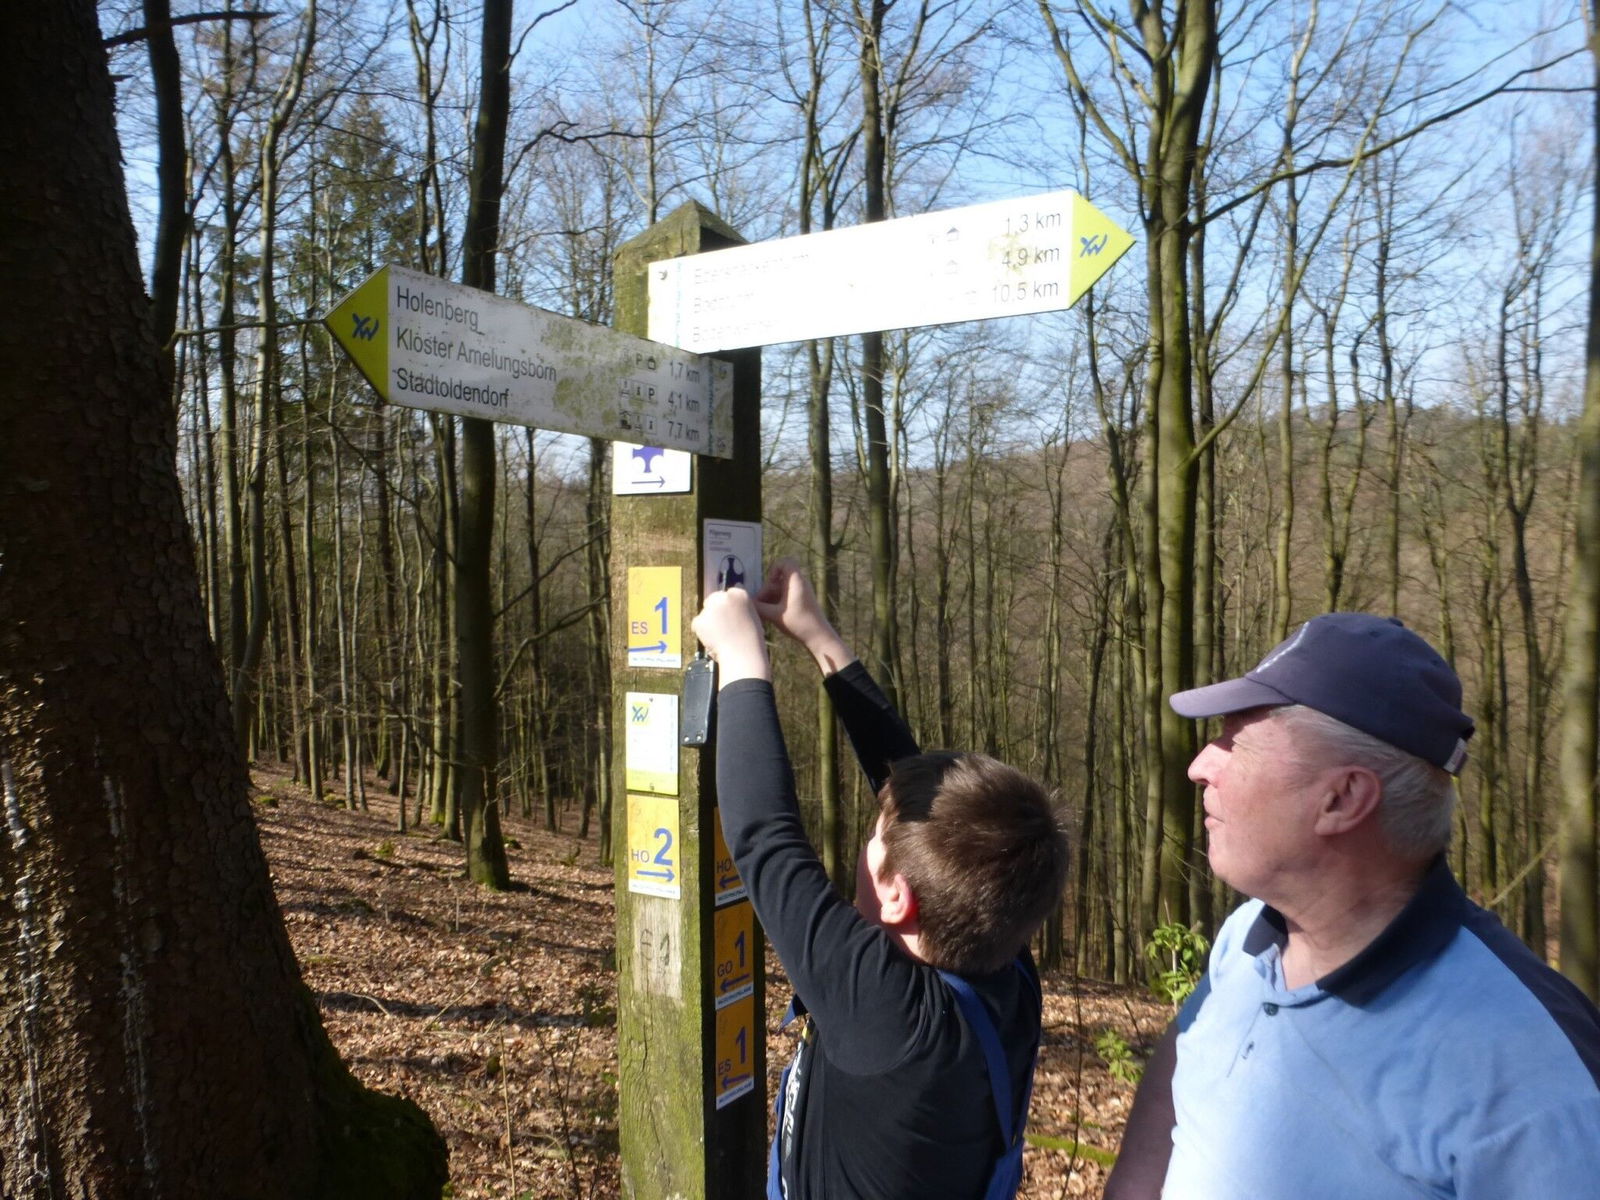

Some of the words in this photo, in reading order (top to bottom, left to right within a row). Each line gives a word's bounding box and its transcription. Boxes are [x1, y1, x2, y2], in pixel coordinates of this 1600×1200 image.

[1036, 212, 1061, 229] km
[1034, 246, 1060, 264] km
[1033, 280, 1059, 298] km
[397, 285, 479, 332] Holenberg
[397, 326, 453, 359] Kloster
[456, 341, 557, 382] Amelungsborn
[397, 367, 509, 409] Stadtoldendorf
[686, 365, 700, 384] km
[686, 393, 700, 412] km
[686, 423, 700, 442] km
[631, 621, 648, 635] ES
[654, 597, 668, 635] 1
[631, 848, 650, 863] HO
[653, 828, 673, 866] 2
[716, 859, 732, 873] HO
[717, 960, 732, 977] GO
[735, 930, 745, 968] 1
[718, 1058, 732, 1076] ES
[735, 1026, 746, 1064] 1
